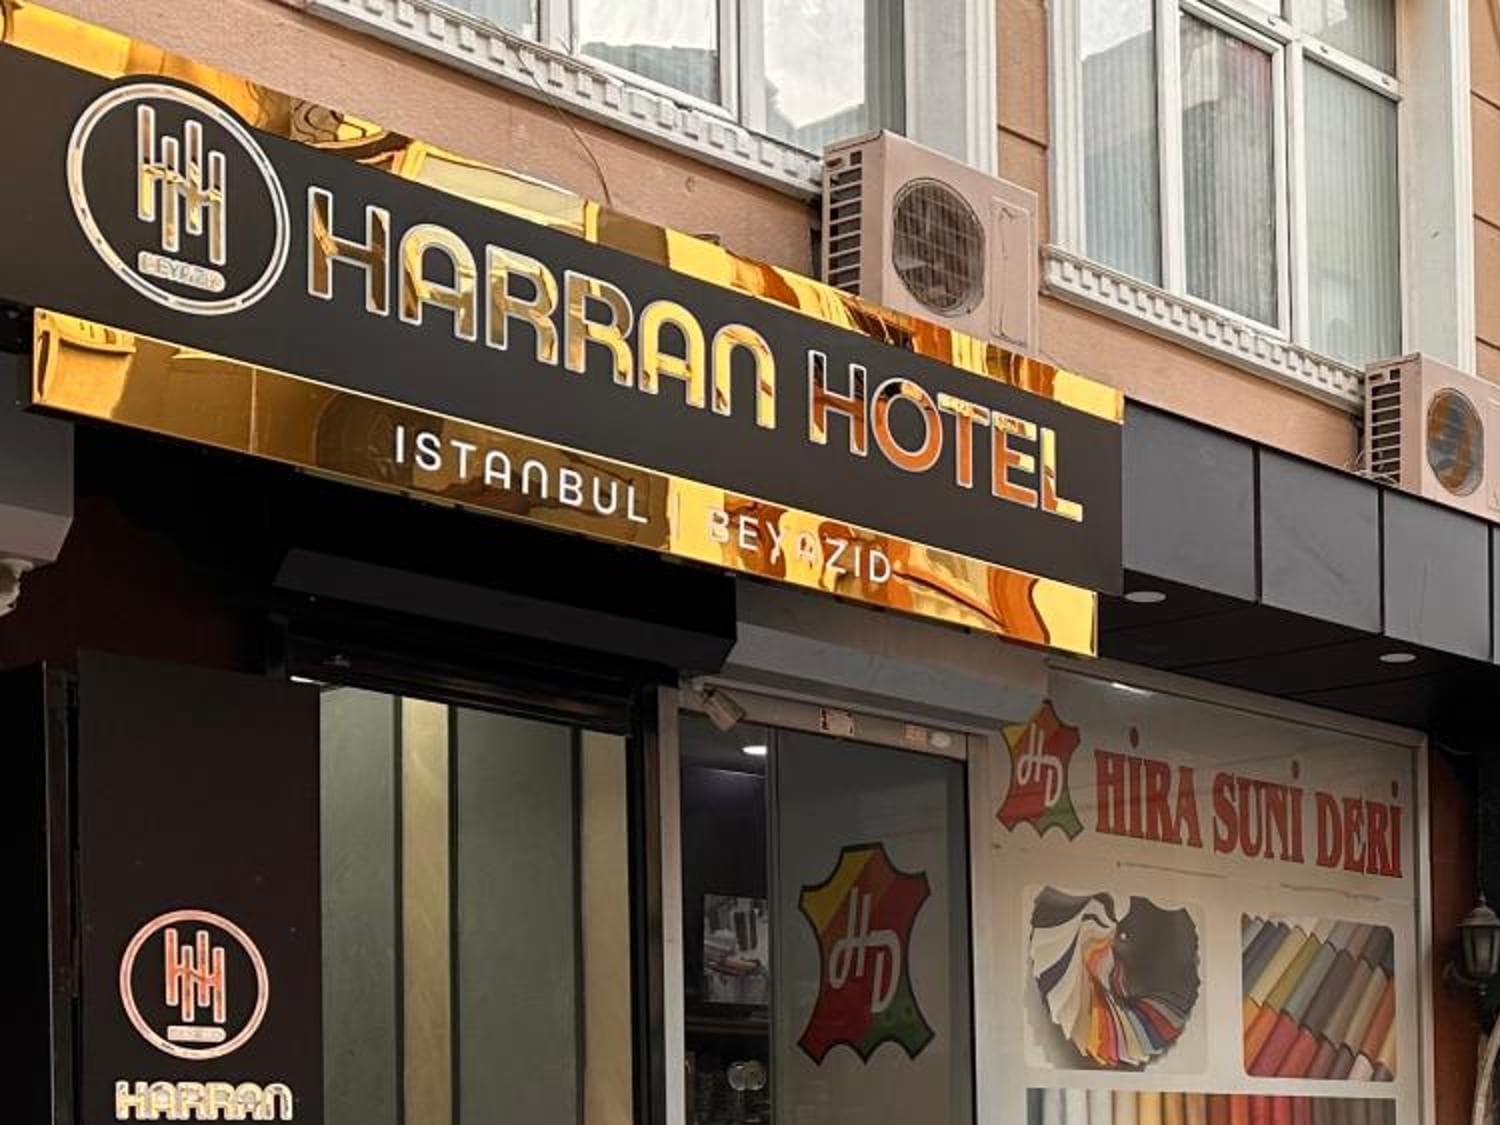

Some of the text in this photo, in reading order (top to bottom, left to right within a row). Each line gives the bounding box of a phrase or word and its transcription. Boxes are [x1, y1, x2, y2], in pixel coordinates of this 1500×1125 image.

[308, 185, 1084, 523] HARRAN HOTEL
[395, 425, 892, 583] ISTANBUL BEYAZID
[1094, 727, 1403, 878] HİRA SUNİ DERİ
[115, 1080, 294, 1121] HARRAN
